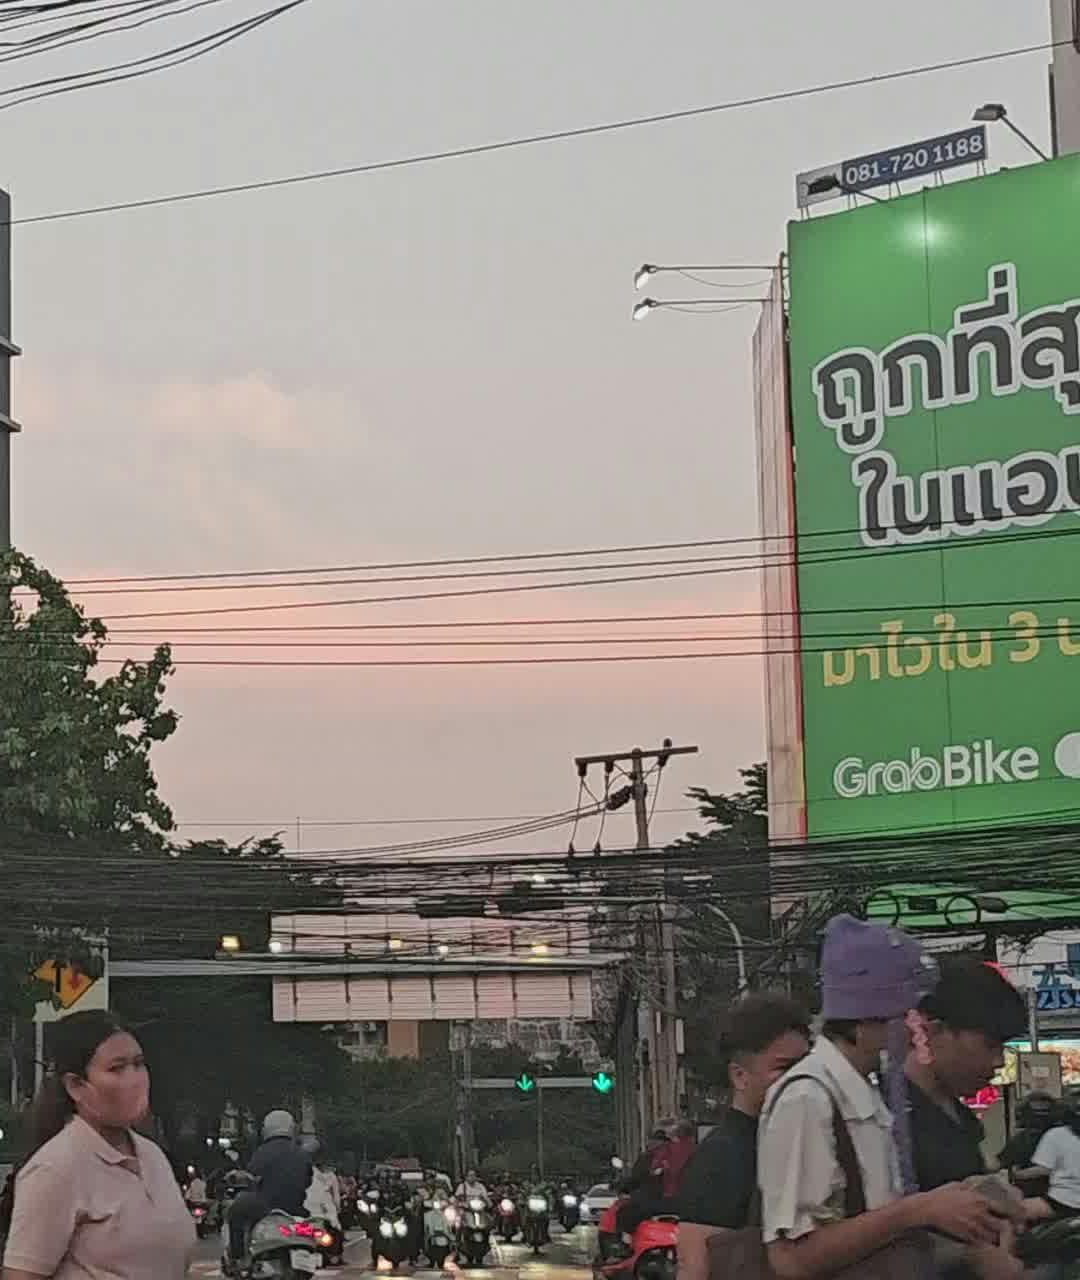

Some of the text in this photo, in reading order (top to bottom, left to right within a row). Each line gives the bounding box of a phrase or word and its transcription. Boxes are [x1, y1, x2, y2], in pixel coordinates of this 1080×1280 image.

[845, 134, 984, 185] 081-720 1188
[1007, 610, 1041, 663] 3
[832, 738, 1040, 799] GrabBike
